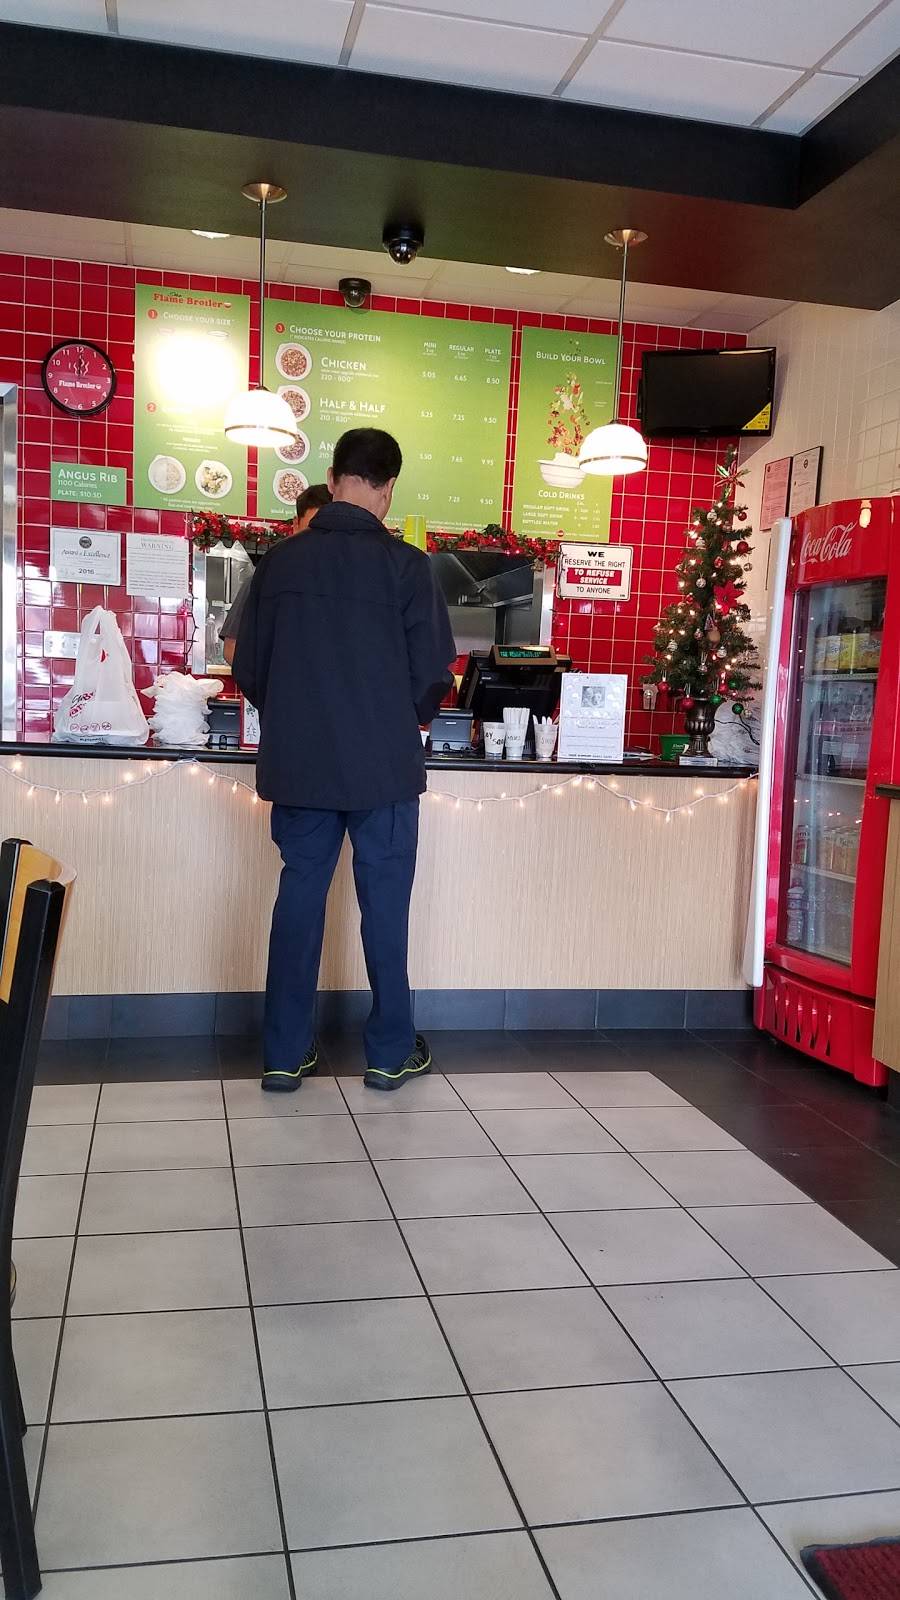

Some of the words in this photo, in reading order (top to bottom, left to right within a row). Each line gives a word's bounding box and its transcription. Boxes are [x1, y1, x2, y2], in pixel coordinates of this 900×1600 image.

[153, 293, 184, 304] Flame
[186, 297, 223, 308] Broiler
[289, 325, 322, 336] CHOOSE
[324, 330, 346, 339] YOUR
[348, 332, 381, 342] PROTEIN
[321, 357, 366, 370] CHICKEN
[536, 352, 558, 360] BUILD
[561, 353, 581, 362] YOUR
[320, 398, 345, 409] HALF
[349, 400, 356, 410] &
[360, 401, 385, 413] HALF
[58, 468, 96, 481] ANGUS
[99, 472, 118, 482] RIB
[538, 490, 557, 498] COLD
[559, 492, 584, 500] DRINKS
[800, 521, 856, 565] Coca-Cola
[565, 558, 591, 566] RESERVE
